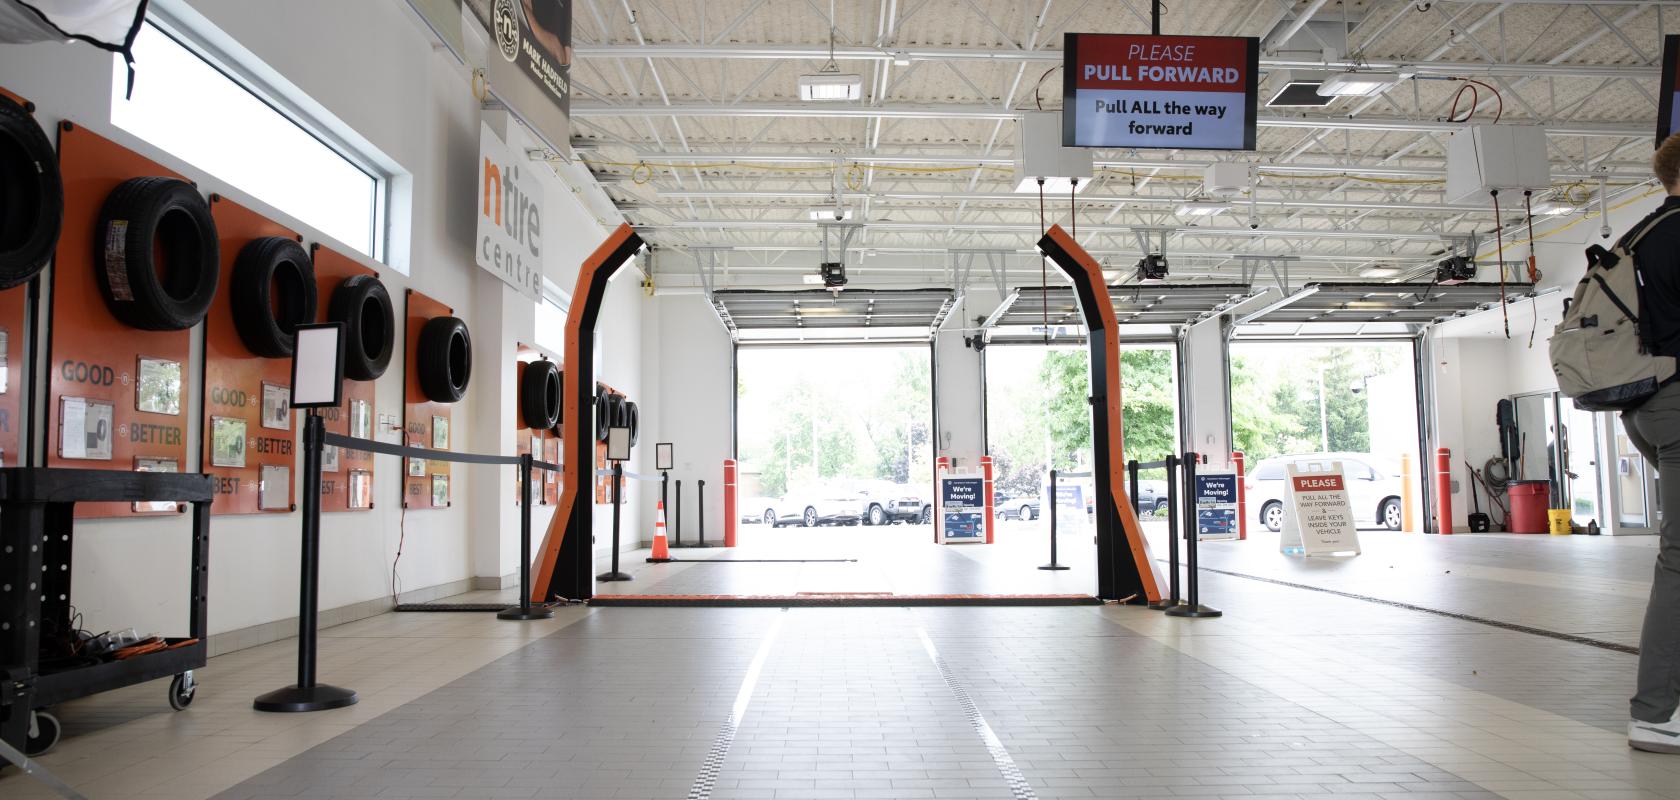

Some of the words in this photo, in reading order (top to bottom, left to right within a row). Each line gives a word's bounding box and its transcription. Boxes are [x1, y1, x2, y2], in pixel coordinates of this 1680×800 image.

[1128, 44, 1196, 61] PLEASE
[523, 37, 541, 67] MARK
[542, 58, 568, 94] HADFIELD
[1084, 64, 1133, 82] PULL
[1138, 65, 1240, 84] FORWARD
[1095, 99, 1127, 114] Pull
[1131, 100, 1161, 115] ALL
[1164, 101, 1191, 115] the
[1195, 105, 1227, 119] way
[1128, 121, 1193, 136] forward
[483, 155, 541, 258] ntire
[483, 234, 540, 295] centre
[62, 361, 114, 386] GOOD
[211, 387, 247, 407] GOOD
[131, 424, 181, 445] BETTER
[410, 422, 424, 435] GOOD
[257, 436, 292, 456] BETTER
[322, 480, 336, 496] EST
[410, 484, 422, 496] BEST
[1203, 489, 1229, 497] Moving!
[1301, 479, 1336, 488] PLEASE
